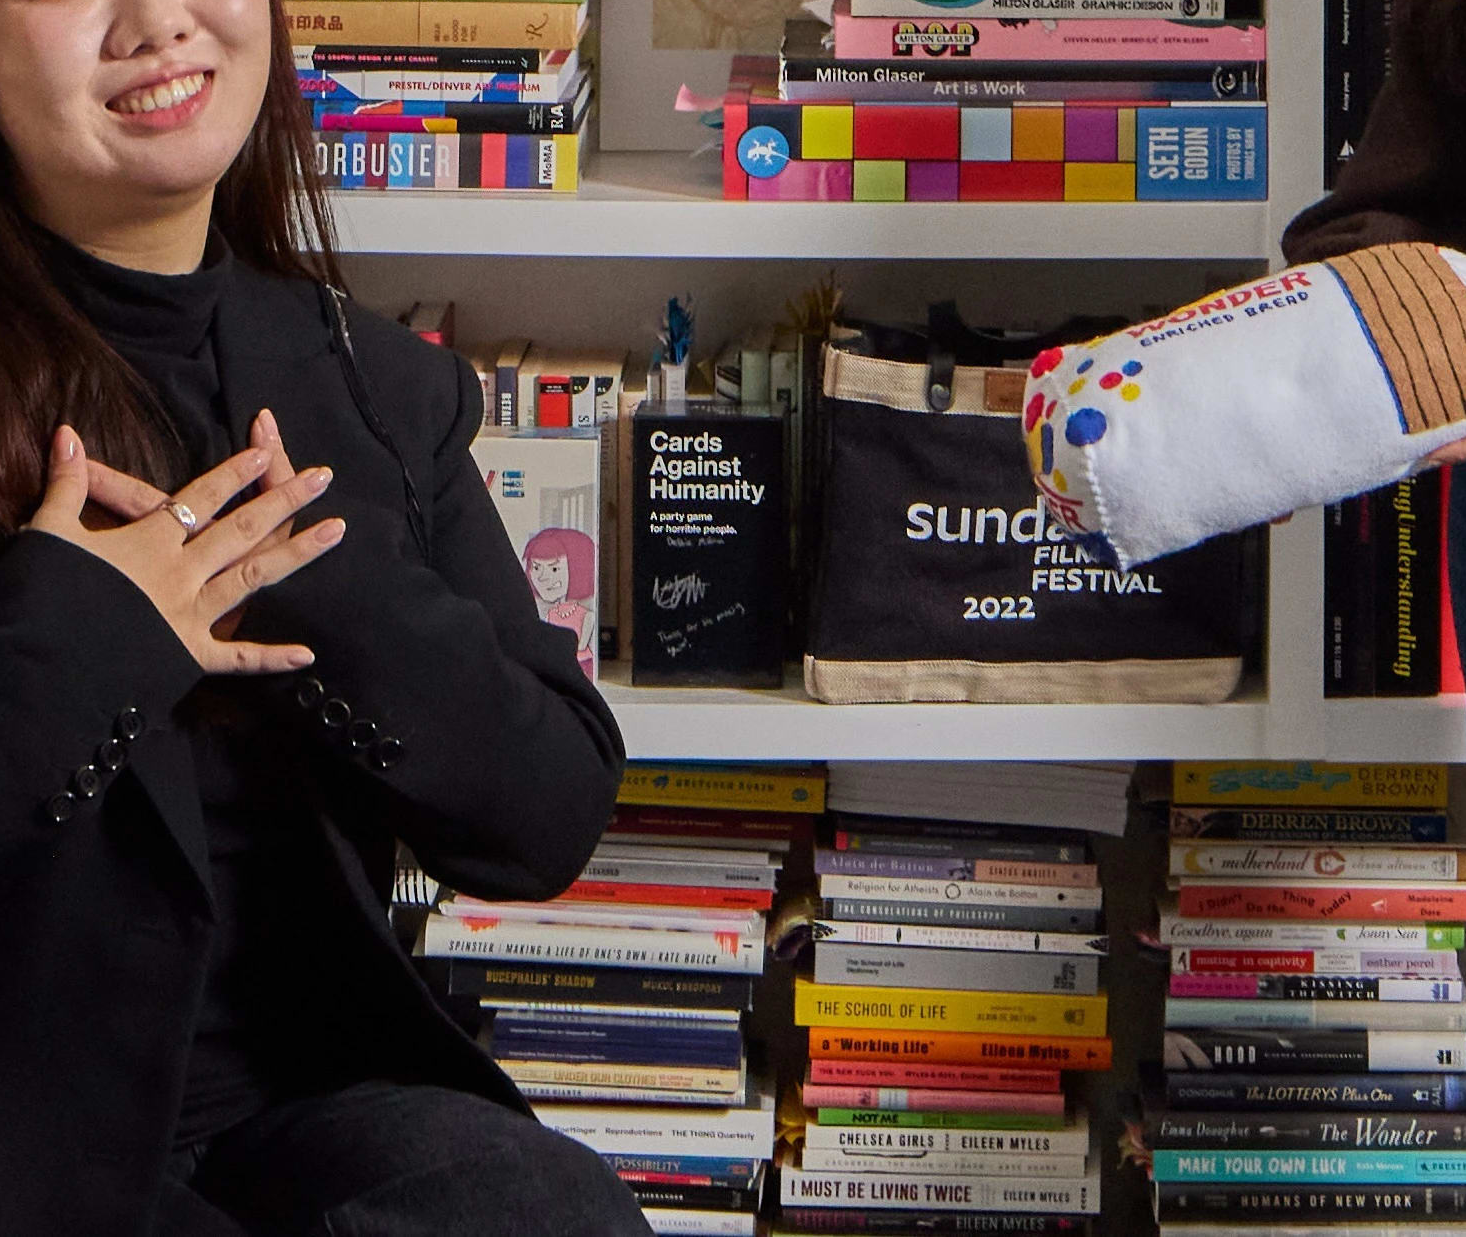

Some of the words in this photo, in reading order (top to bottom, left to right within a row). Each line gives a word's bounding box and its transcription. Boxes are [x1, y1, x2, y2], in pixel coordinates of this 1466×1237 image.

[816, 67, 868, 83] Milton
[873, 68, 926, 84] Glaser
[933, 81, 959, 95] Art
[964, 82, 977, 95] is
[982, 81, 1025, 96] Work
[1149, 127, 1179, 180] SETH
[1184, 127, 1209, 181] GODIN
[1124, 269, 1314, 340] WONDER
[1139, 314, 1235, 349] ENRICHED
[1246, 290, 1310, 318] BREAD
[649, 431, 722, 453] Cards
[649, 456, 742, 479] Against
[649, 479, 764, 504] Humanity
[650, 512, 657, 521] A
[659, 512, 685, 524] party
[687, 513, 712, 523] game
[906, 496, 1065, 544] sund
[650, 524, 664, 533] for
[665, 524, 700, 533] horrible
[703, 525, 737, 536] people.
[1031, 568, 1162, 594] FESTIVAL
[962, 597, 1036, 620] 2022
[817, 1001, 842, 1015] THE
[845, 1003, 895, 1018] SCHOOL
[900, 1004, 914, 1018] OF
[920, 1005, 947, 1019] LIFE
[839, 1133, 893, 1146] CHELSEA
[899, 1135, 934, 1147] GIRLS
[791, 1179, 796, 1196] I
[801, 1180, 841, 1197] MUST
[847, 1182, 865, 1198] BE
[871, 1184, 918, 1200] LIVING
[924, 1185, 972, 1202] TWICE
